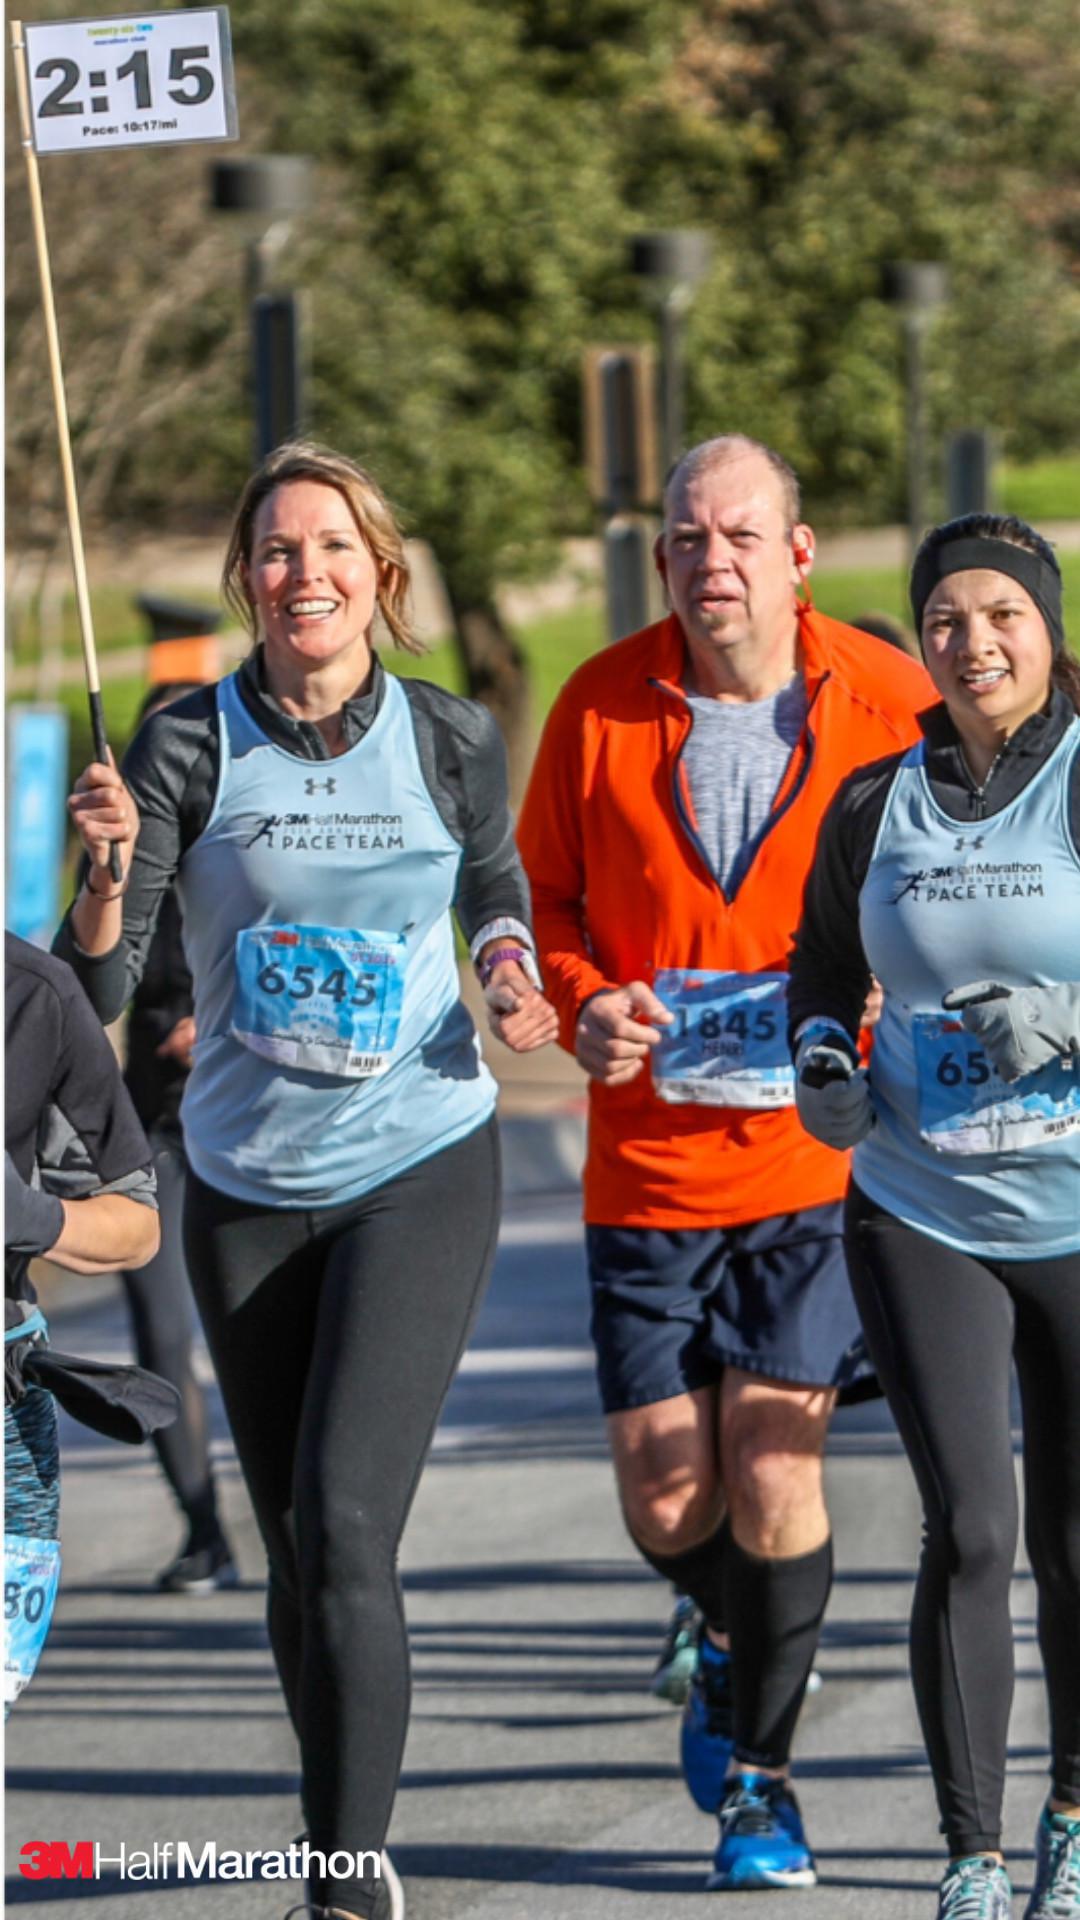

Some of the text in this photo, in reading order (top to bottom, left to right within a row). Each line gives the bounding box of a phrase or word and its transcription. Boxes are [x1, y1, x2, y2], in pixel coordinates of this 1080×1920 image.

[34, 45, 215, 119] 2:15
[82, 118, 178, 137] Pace: 10:17/mi
[282, 835, 404, 850] PACE TEAM
[926, 883, 1044, 902] PACE TEAM
[257, 962, 377, 1007] 6545
[677, 1007, 776, 1041] 1845
[936, 1051, 999, 1087] 65
